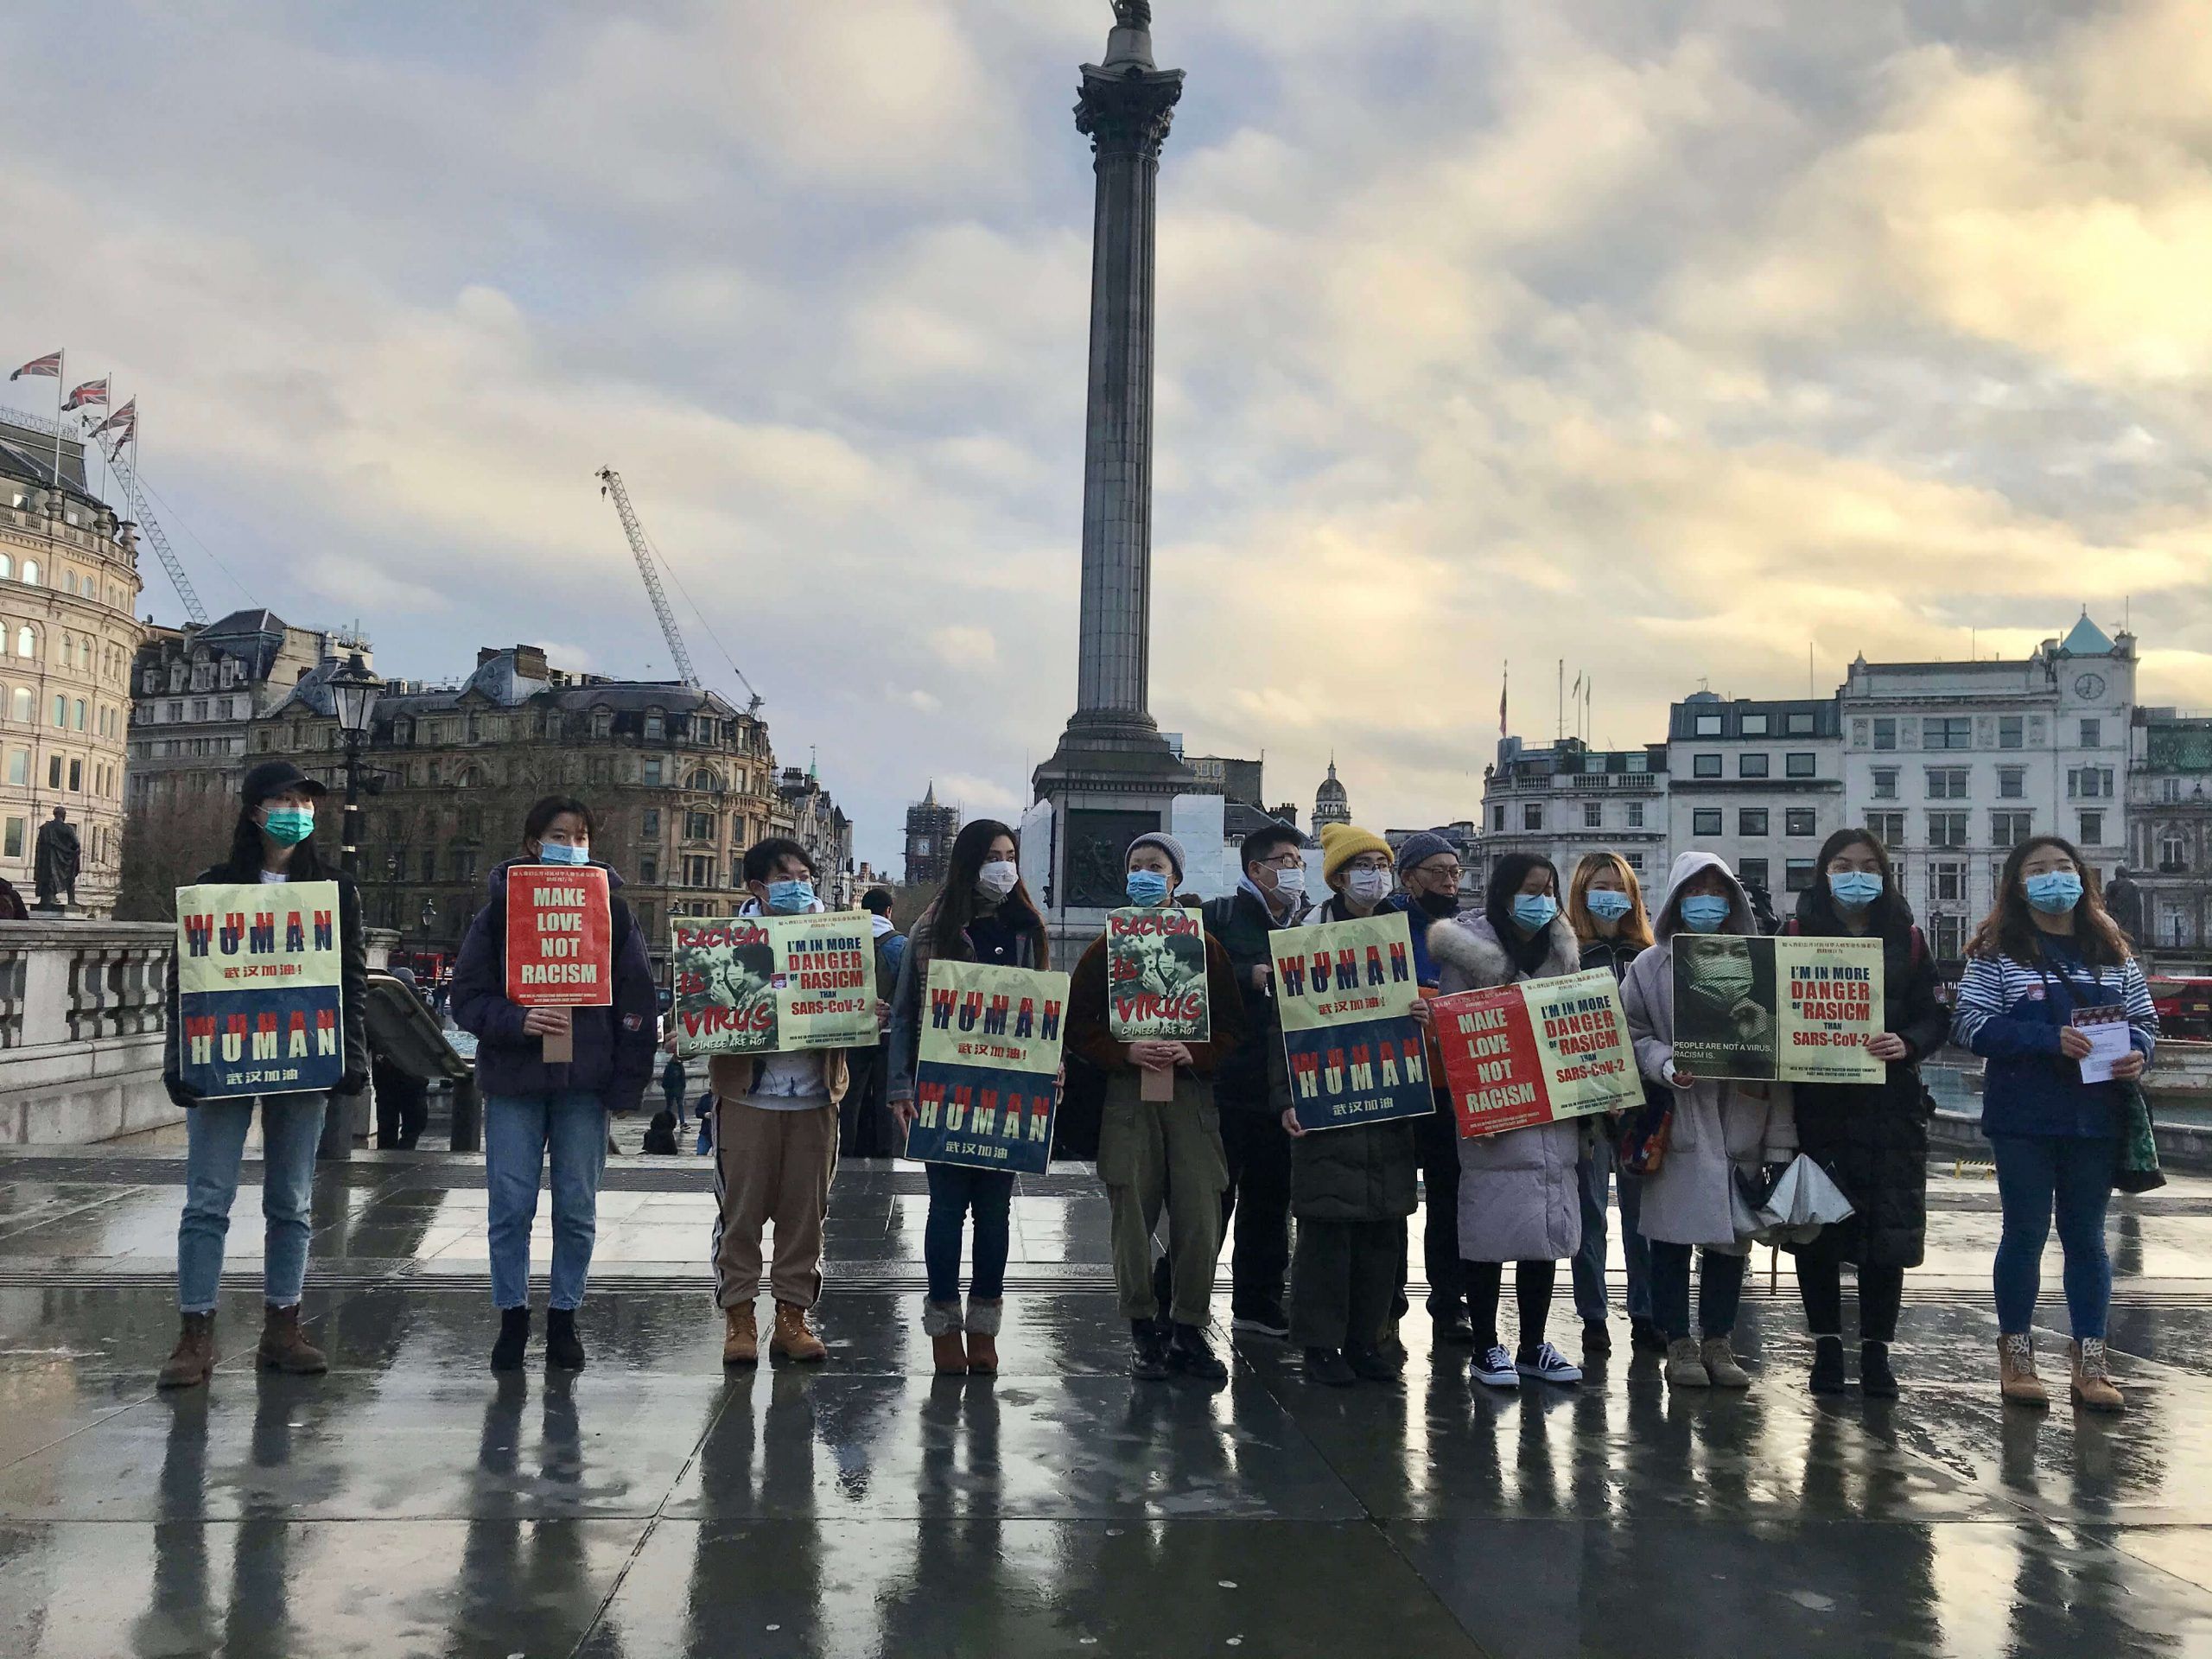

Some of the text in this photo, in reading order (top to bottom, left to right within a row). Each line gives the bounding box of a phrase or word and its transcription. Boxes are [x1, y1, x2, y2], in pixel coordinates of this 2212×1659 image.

[534, 888, 585, 906] MAKE
[537, 912, 582, 931] LOVE
[1110, 916, 1198, 937] RACISM
[677, 926, 769, 949] RACISM
[788, 938, 861, 952] I'M IN MORE
[542, 938, 580, 957] NOT
[789, 951, 862, 971] DANGER
[1114, 957, 1137, 982] IS
[522, 964, 597, 983] RACISM
[801, 970, 863, 989] RASICM
[1791, 966, 1870, 980] I'M IN MORE
[680, 972, 705, 995] IS
[1791, 981, 1870, 1001] DANGER
[791, 998, 865, 1015] SARS-CoV-2
[1116, 992, 1202, 1023] VIRUS
[1541, 995, 1611, 1019] I'M IN MORE
[1803, 1002, 1870, 1020] RASICM
[683, 1002, 772, 1037] VIRUS
[1458, 1007, 1508, 1034] MAKE
[1544, 1010, 1616, 1039] DANGER
[1122, 1026, 1198, 1035] CHINESE ARE NOT
[1793, 1032, 1871, 1046] SARS-CoV-2
[690, 1037, 767, 1050] CHINESE ARE NOT
[1467, 1034, 1510, 1058] LOVE
[1560, 1030, 1620, 1056] RASICM
[1580, 1053, 1597, 1063] THAN
[226, 1069, 298, 1084] 武汉加油
[1478, 1059, 1512, 1084] NOT
[1556, 1058, 1625, 1083] SARS-CoV-2
[1332, 1097, 1394, 1116] 武汉加油
[1466, 1082, 1536, 1114] RACISM
[945, 1141, 1008, 1159] 武汉加油
